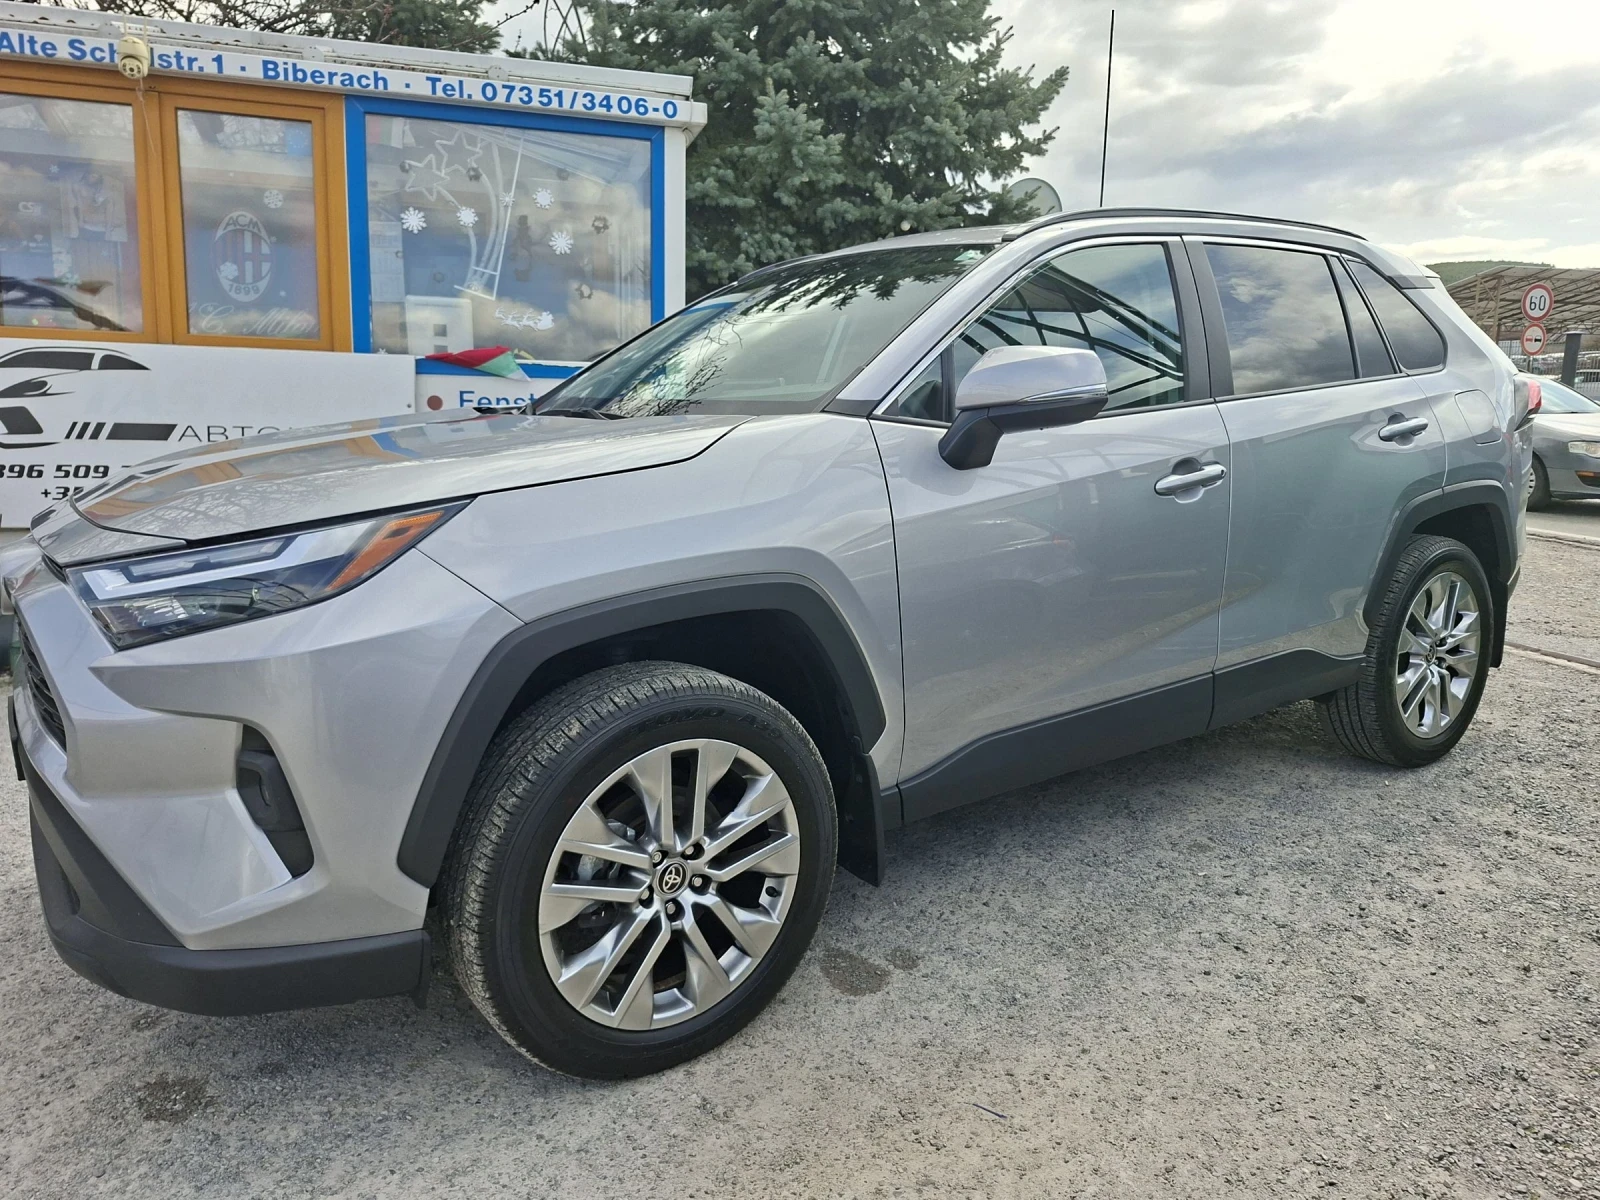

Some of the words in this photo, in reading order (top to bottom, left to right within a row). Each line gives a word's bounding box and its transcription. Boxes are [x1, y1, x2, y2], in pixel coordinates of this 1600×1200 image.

[0, 31, 57, 58] Alte
[262, 60, 389, 91] Biberach
[426, 76, 473, 100] Tel.
[481, 81, 679, 119] 07351/3406-0
[223, 213, 262, 233] ACM
[227, 283, 261, 296] 1899
[1529, 294, 1547, 312] 60
[53, 464, 110, 479] 509
